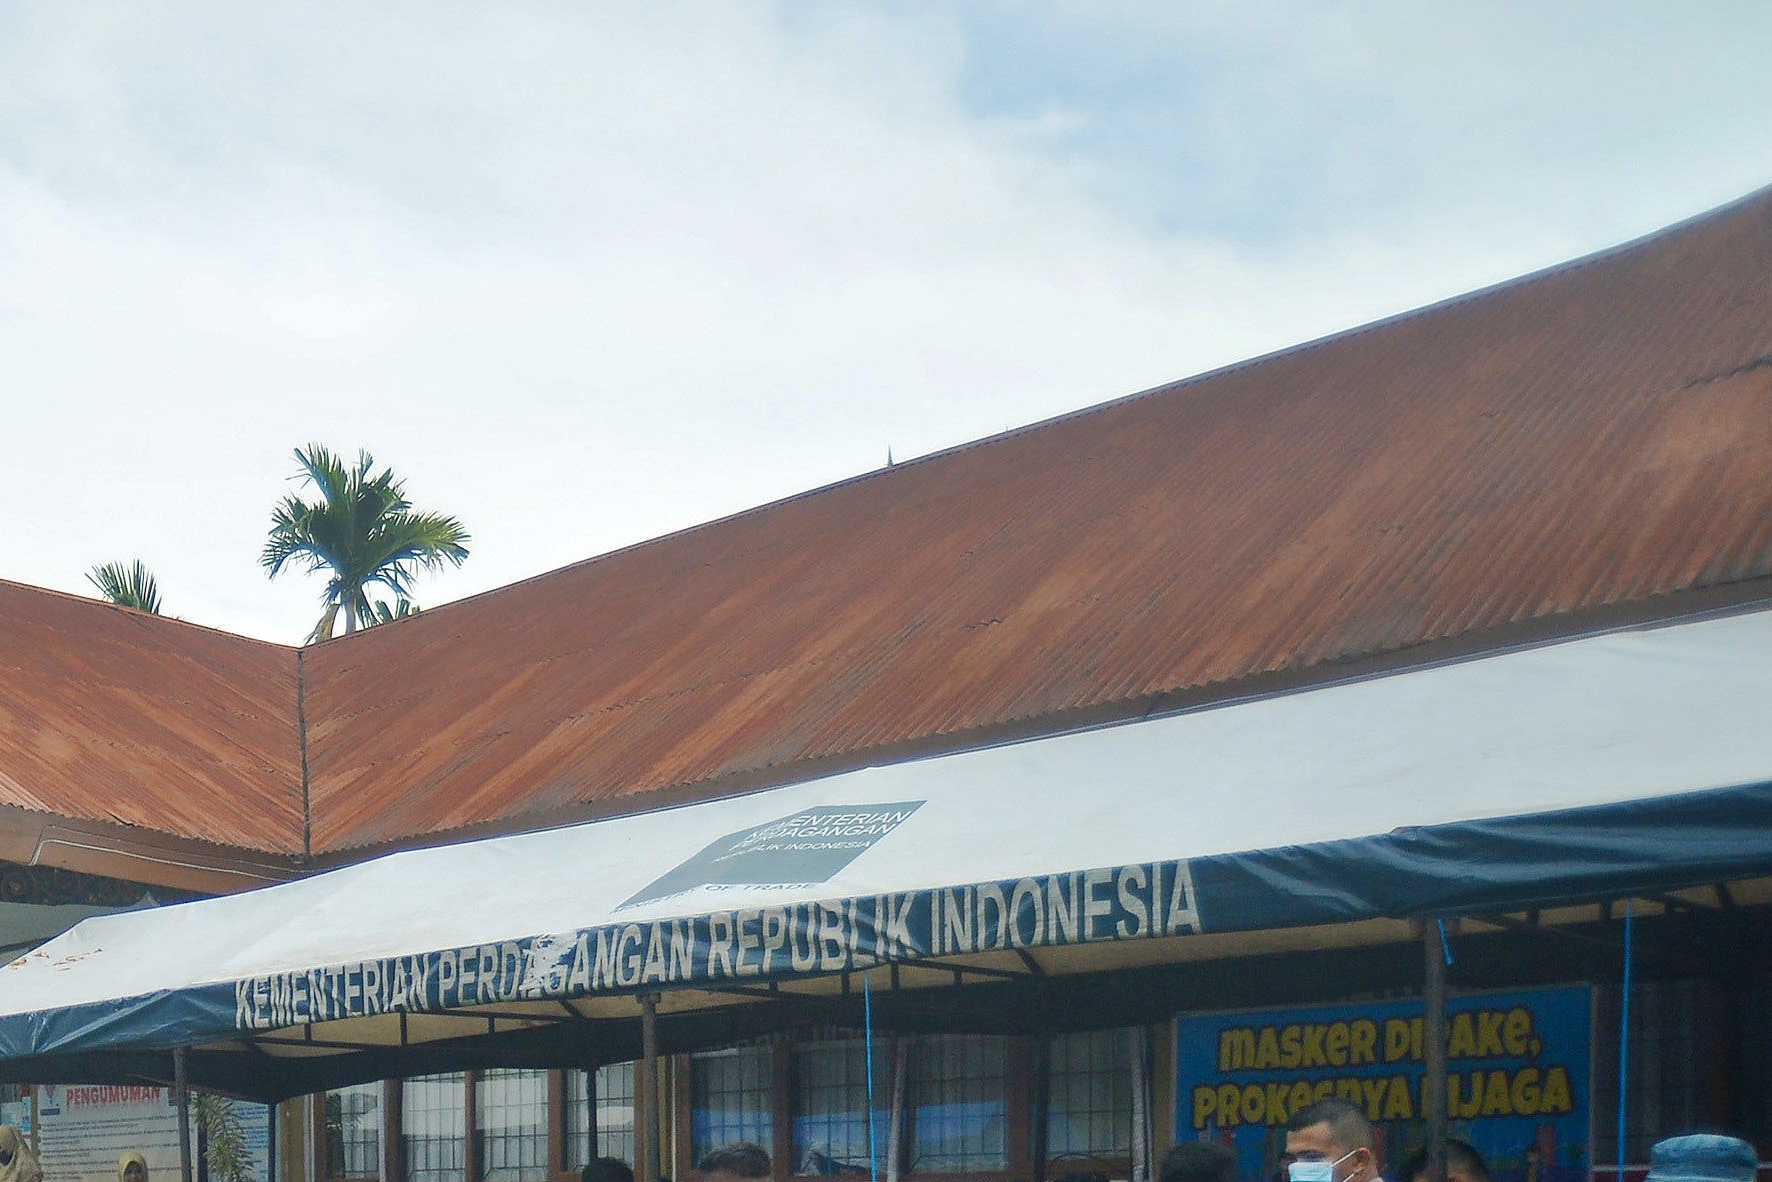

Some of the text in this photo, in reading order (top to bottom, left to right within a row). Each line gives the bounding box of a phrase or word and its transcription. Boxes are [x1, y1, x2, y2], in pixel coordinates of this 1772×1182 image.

[784, 840, 871, 851] INDONESIA
[234, 858, 1204, 1030] KEMENTERIAN PERDAGANGAN REPUBLIK INDONESIA
[1219, 1007, 1542, 1072] MASKER DIAKE,
[66, 1085, 161, 1106] PENGUMUMAN
